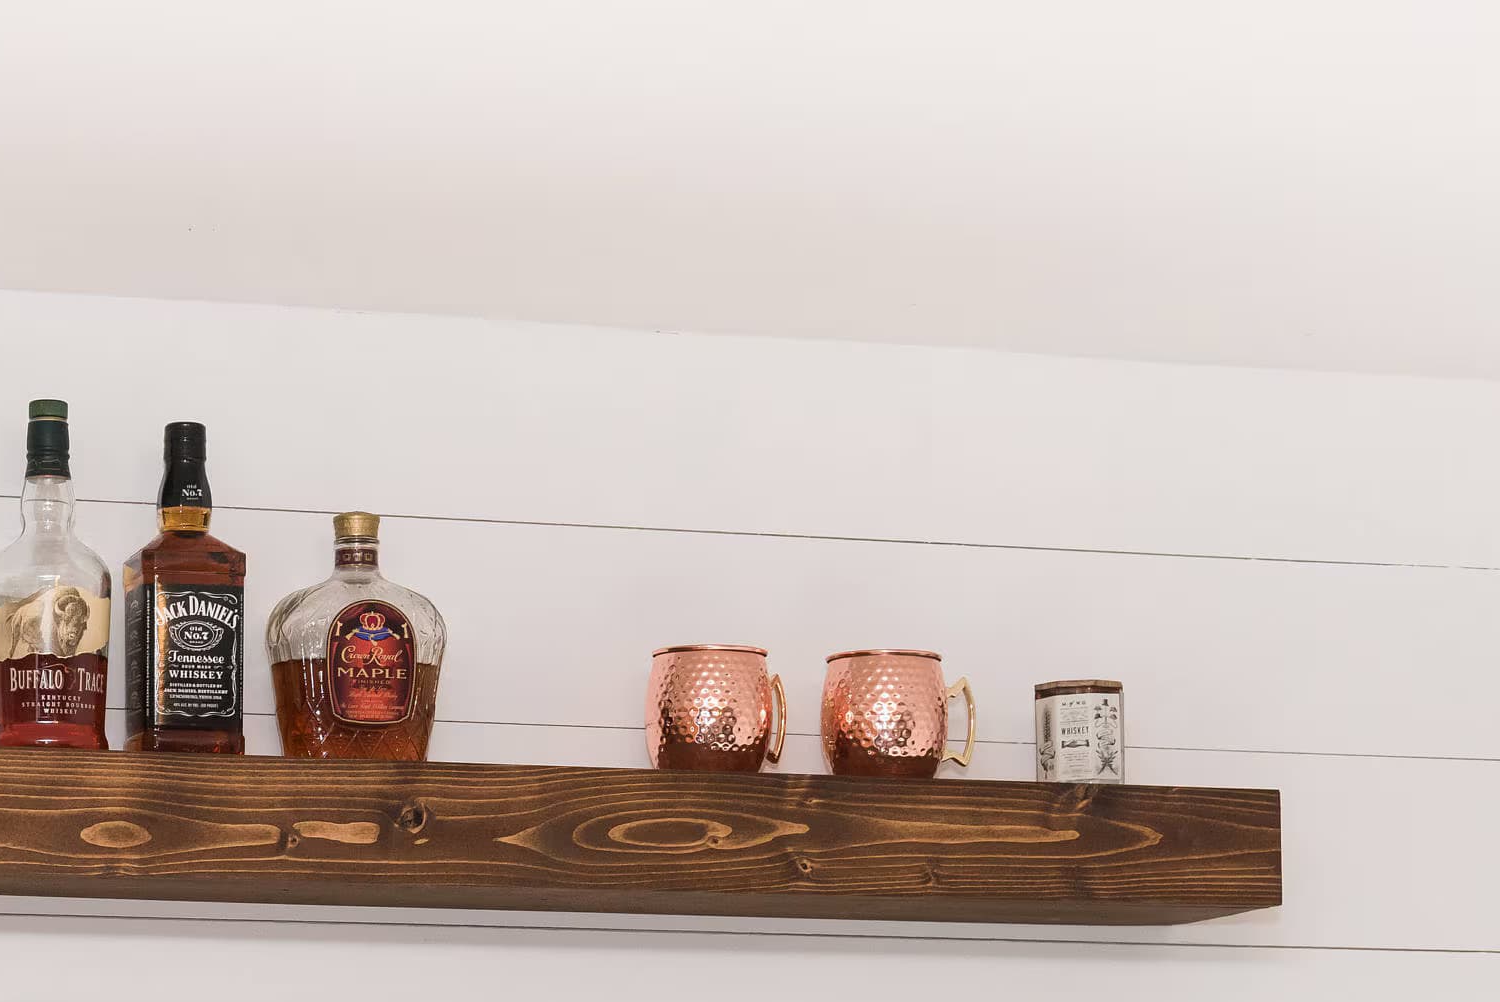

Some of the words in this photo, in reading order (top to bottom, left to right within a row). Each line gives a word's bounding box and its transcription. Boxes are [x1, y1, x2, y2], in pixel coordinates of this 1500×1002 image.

[181, 488, 203, 497] No.7
[155, 599, 189, 626] JACK
[188, 595, 240, 629] DANIEL'S
[183, 631, 210, 641] No.7
[168, 650, 225, 664] Tennessee
[341, 645, 371, 664] Crown
[362, 645, 404, 667] Royal
[10, 667, 63, 692] BUFFALO
[78, 668, 104, 693] TRACE
[168, 669, 224, 680] WHISKEY
[337, 667, 408, 680] MAPLE
[41, 694, 81, 702] KENTUCKY
